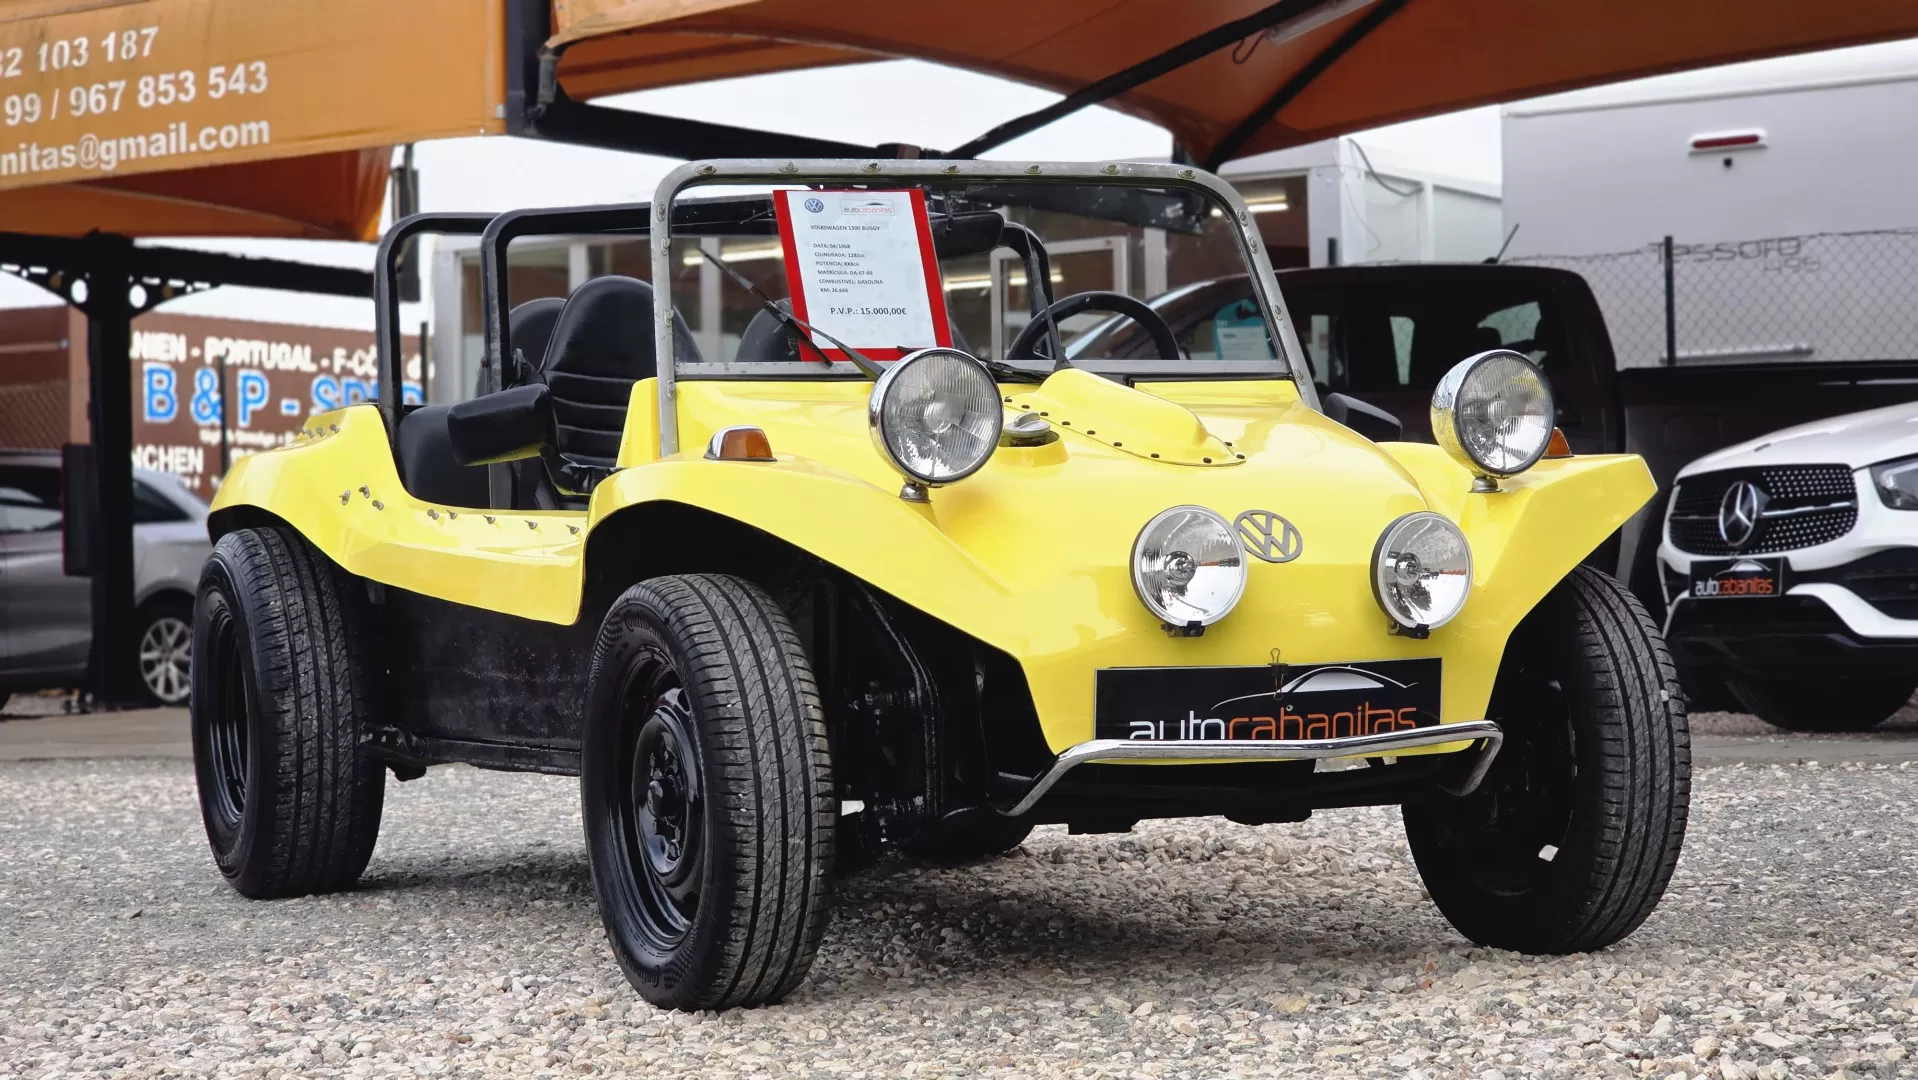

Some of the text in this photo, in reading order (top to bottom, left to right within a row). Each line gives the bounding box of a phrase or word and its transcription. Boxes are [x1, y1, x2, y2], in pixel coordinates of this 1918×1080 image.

[0, 26, 160, 78] 2 103 187
[4, 92, 41, 126] 99
[69, 79, 126, 117] 967
[137, 70, 196, 108] 853
[208, 60, 268, 99] 543
[0, 120, 270, 176] nitas@gmail.com
[860, 307, 907, 316] 15.000,00€
[204, 336, 318, 372] PORTUGAL
[142, 362, 178, 423] B
[237, 368, 270, 428] P
[1695, 576, 1773, 596] autocabanitas
[1129, 701, 1418, 741] autocabanitas
